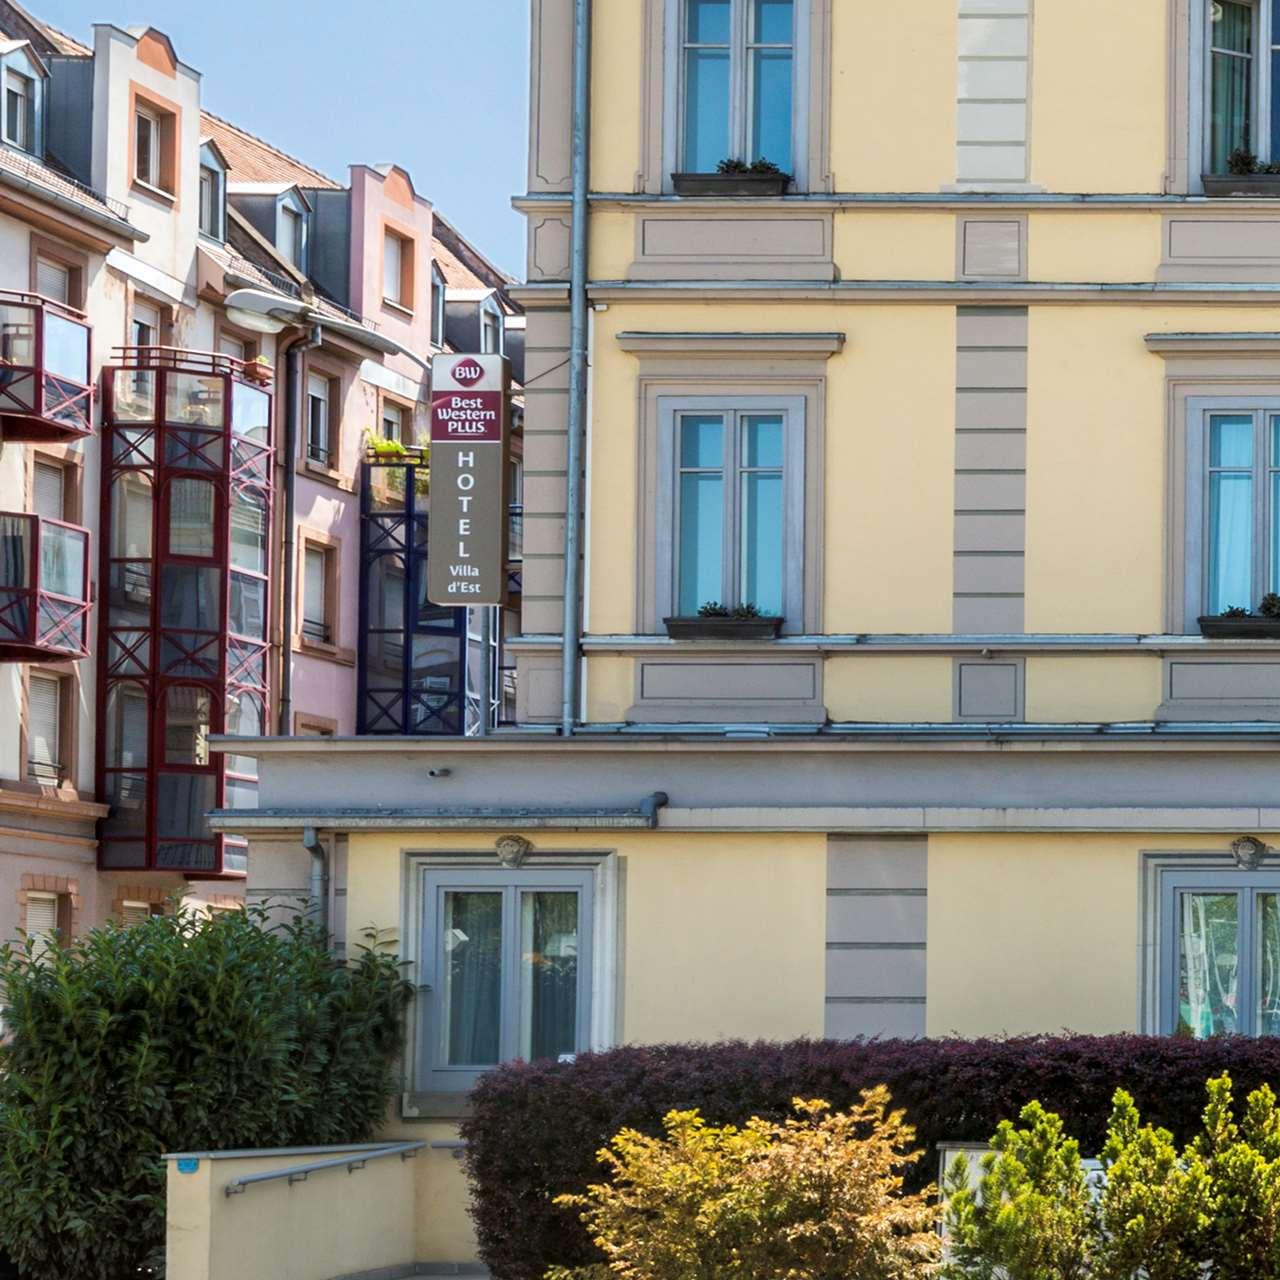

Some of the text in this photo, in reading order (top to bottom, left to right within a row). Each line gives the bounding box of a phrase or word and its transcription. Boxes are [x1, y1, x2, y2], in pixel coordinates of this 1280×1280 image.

[455, 366, 480, 380] BW
[451, 396, 483, 409] Best
[437, 408, 496, 420] Western
[447, 421, 485, 433] PLUS
[456, 451, 475, 558] HOTEL
[449, 565, 479, 577] Villa
[447, 582, 481, 593] d'Est
